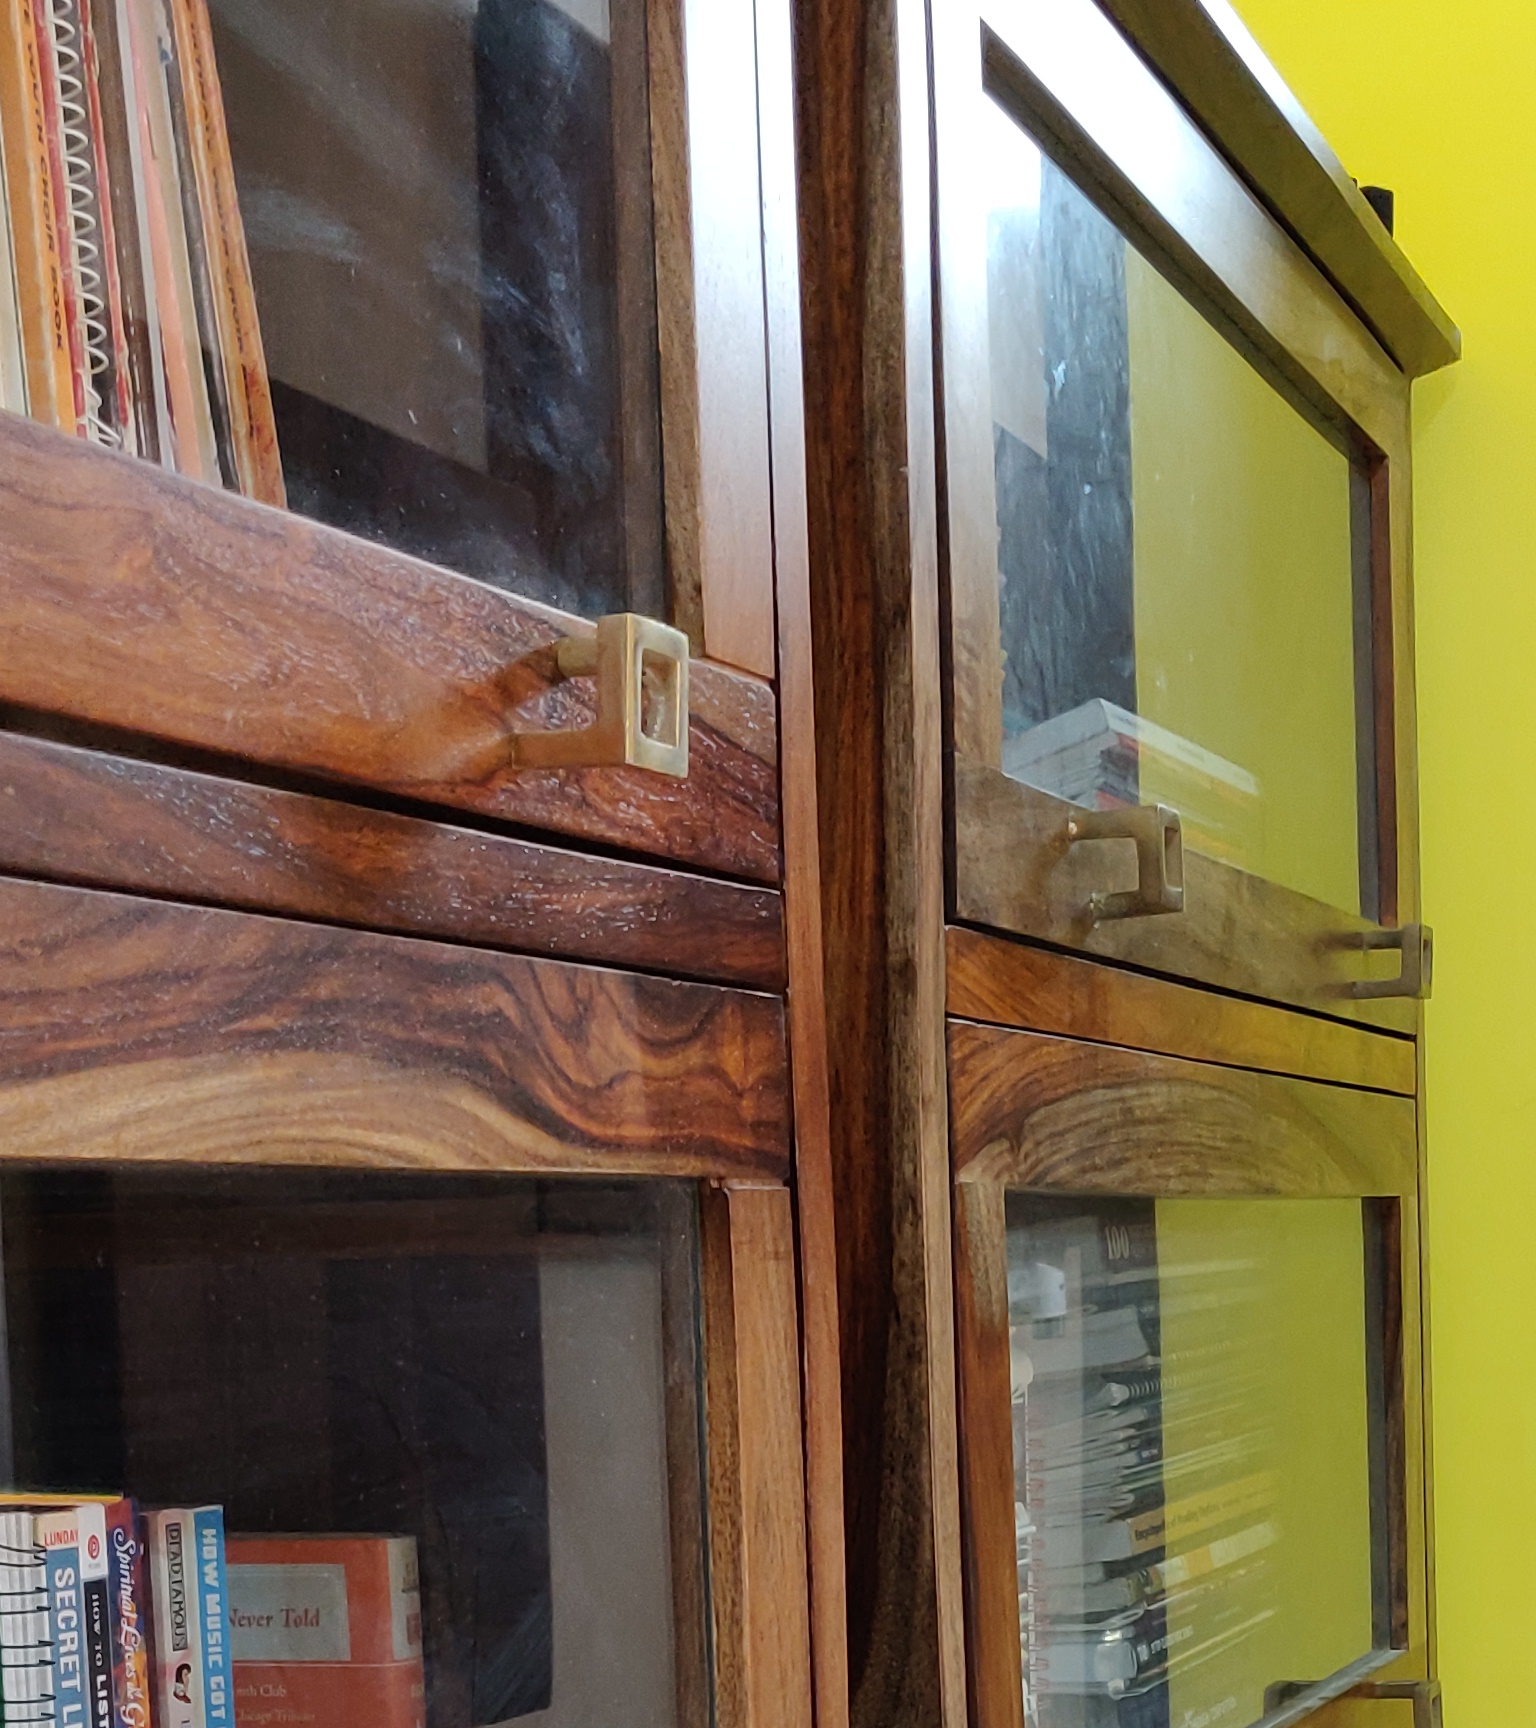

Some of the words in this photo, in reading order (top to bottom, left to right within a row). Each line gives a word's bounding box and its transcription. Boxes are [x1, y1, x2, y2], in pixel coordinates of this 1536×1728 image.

[112, 1527, 139, 1618] Spiritual
[202, 1528, 220, 1587] HOW
[53, 1565, 82, 1694] SECRET
[205, 1594, 224, 1669] MUSIC
[280, 1607, 321, 1629] Told
[93, 1641, 104, 1668] TO
[209, 1675, 226, 1720] GOT
